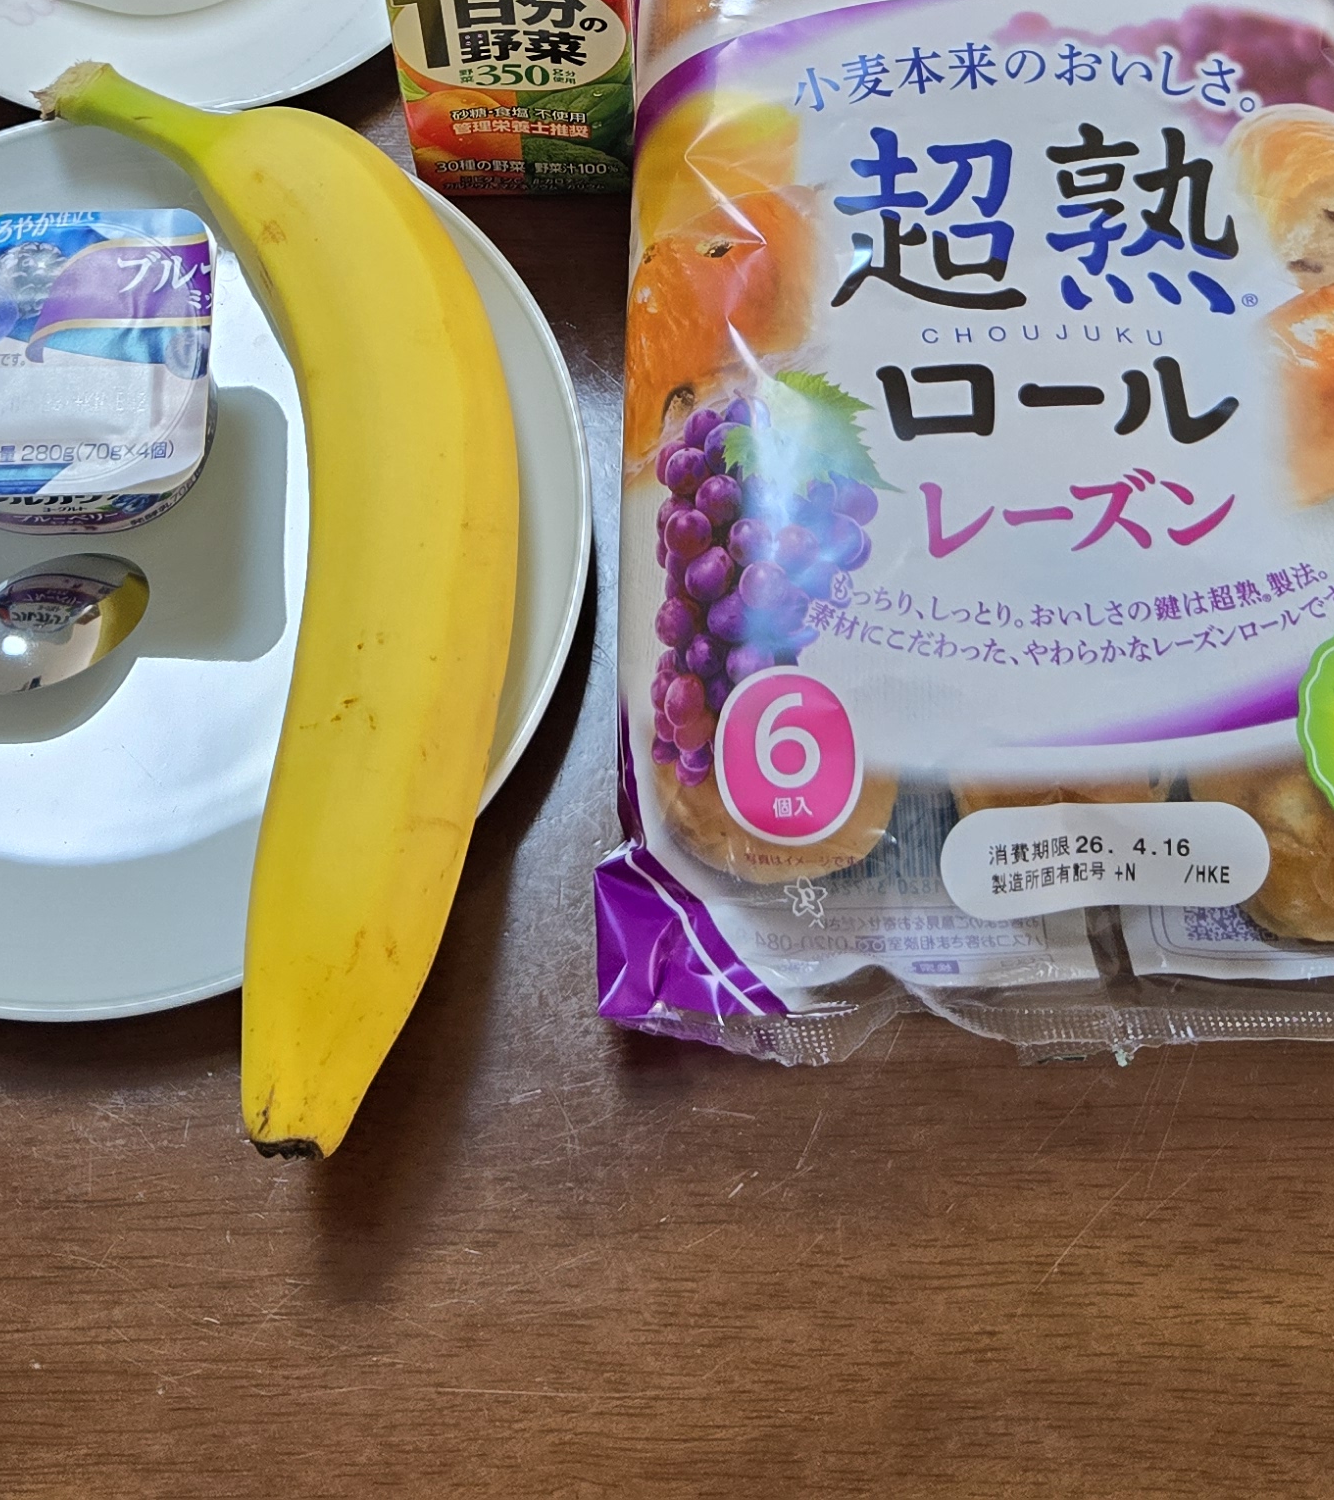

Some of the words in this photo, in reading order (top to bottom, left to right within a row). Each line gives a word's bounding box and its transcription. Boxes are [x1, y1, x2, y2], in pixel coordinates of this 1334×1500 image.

[459, 29, 588, 67] 野菜
[793, 41, 1259, 114] 小麦本来のおいしさ。
[452, 118, 592, 140] 管理栄養士推奨
[534, 108, 588, 124] 不使用
[436, 160, 526, 175] 30種の野菜
[920, 323, 1165, 347] CHOUJUKU
[875, 355, 1241, 445] ロール
[12, 512, 119, 523] ブルーベリー
[918, 466, 1237, 560] レーズン
[754, 692, 822, 790] 6
[772, 796, 814, 819] 個入
[988, 836, 1071, 866] 消費期限
[991, 860, 1107, 895] 製造所固有記号
[1114, 862, 1137, 882] +N
[1183, 864, 1231, 885] /HKE
